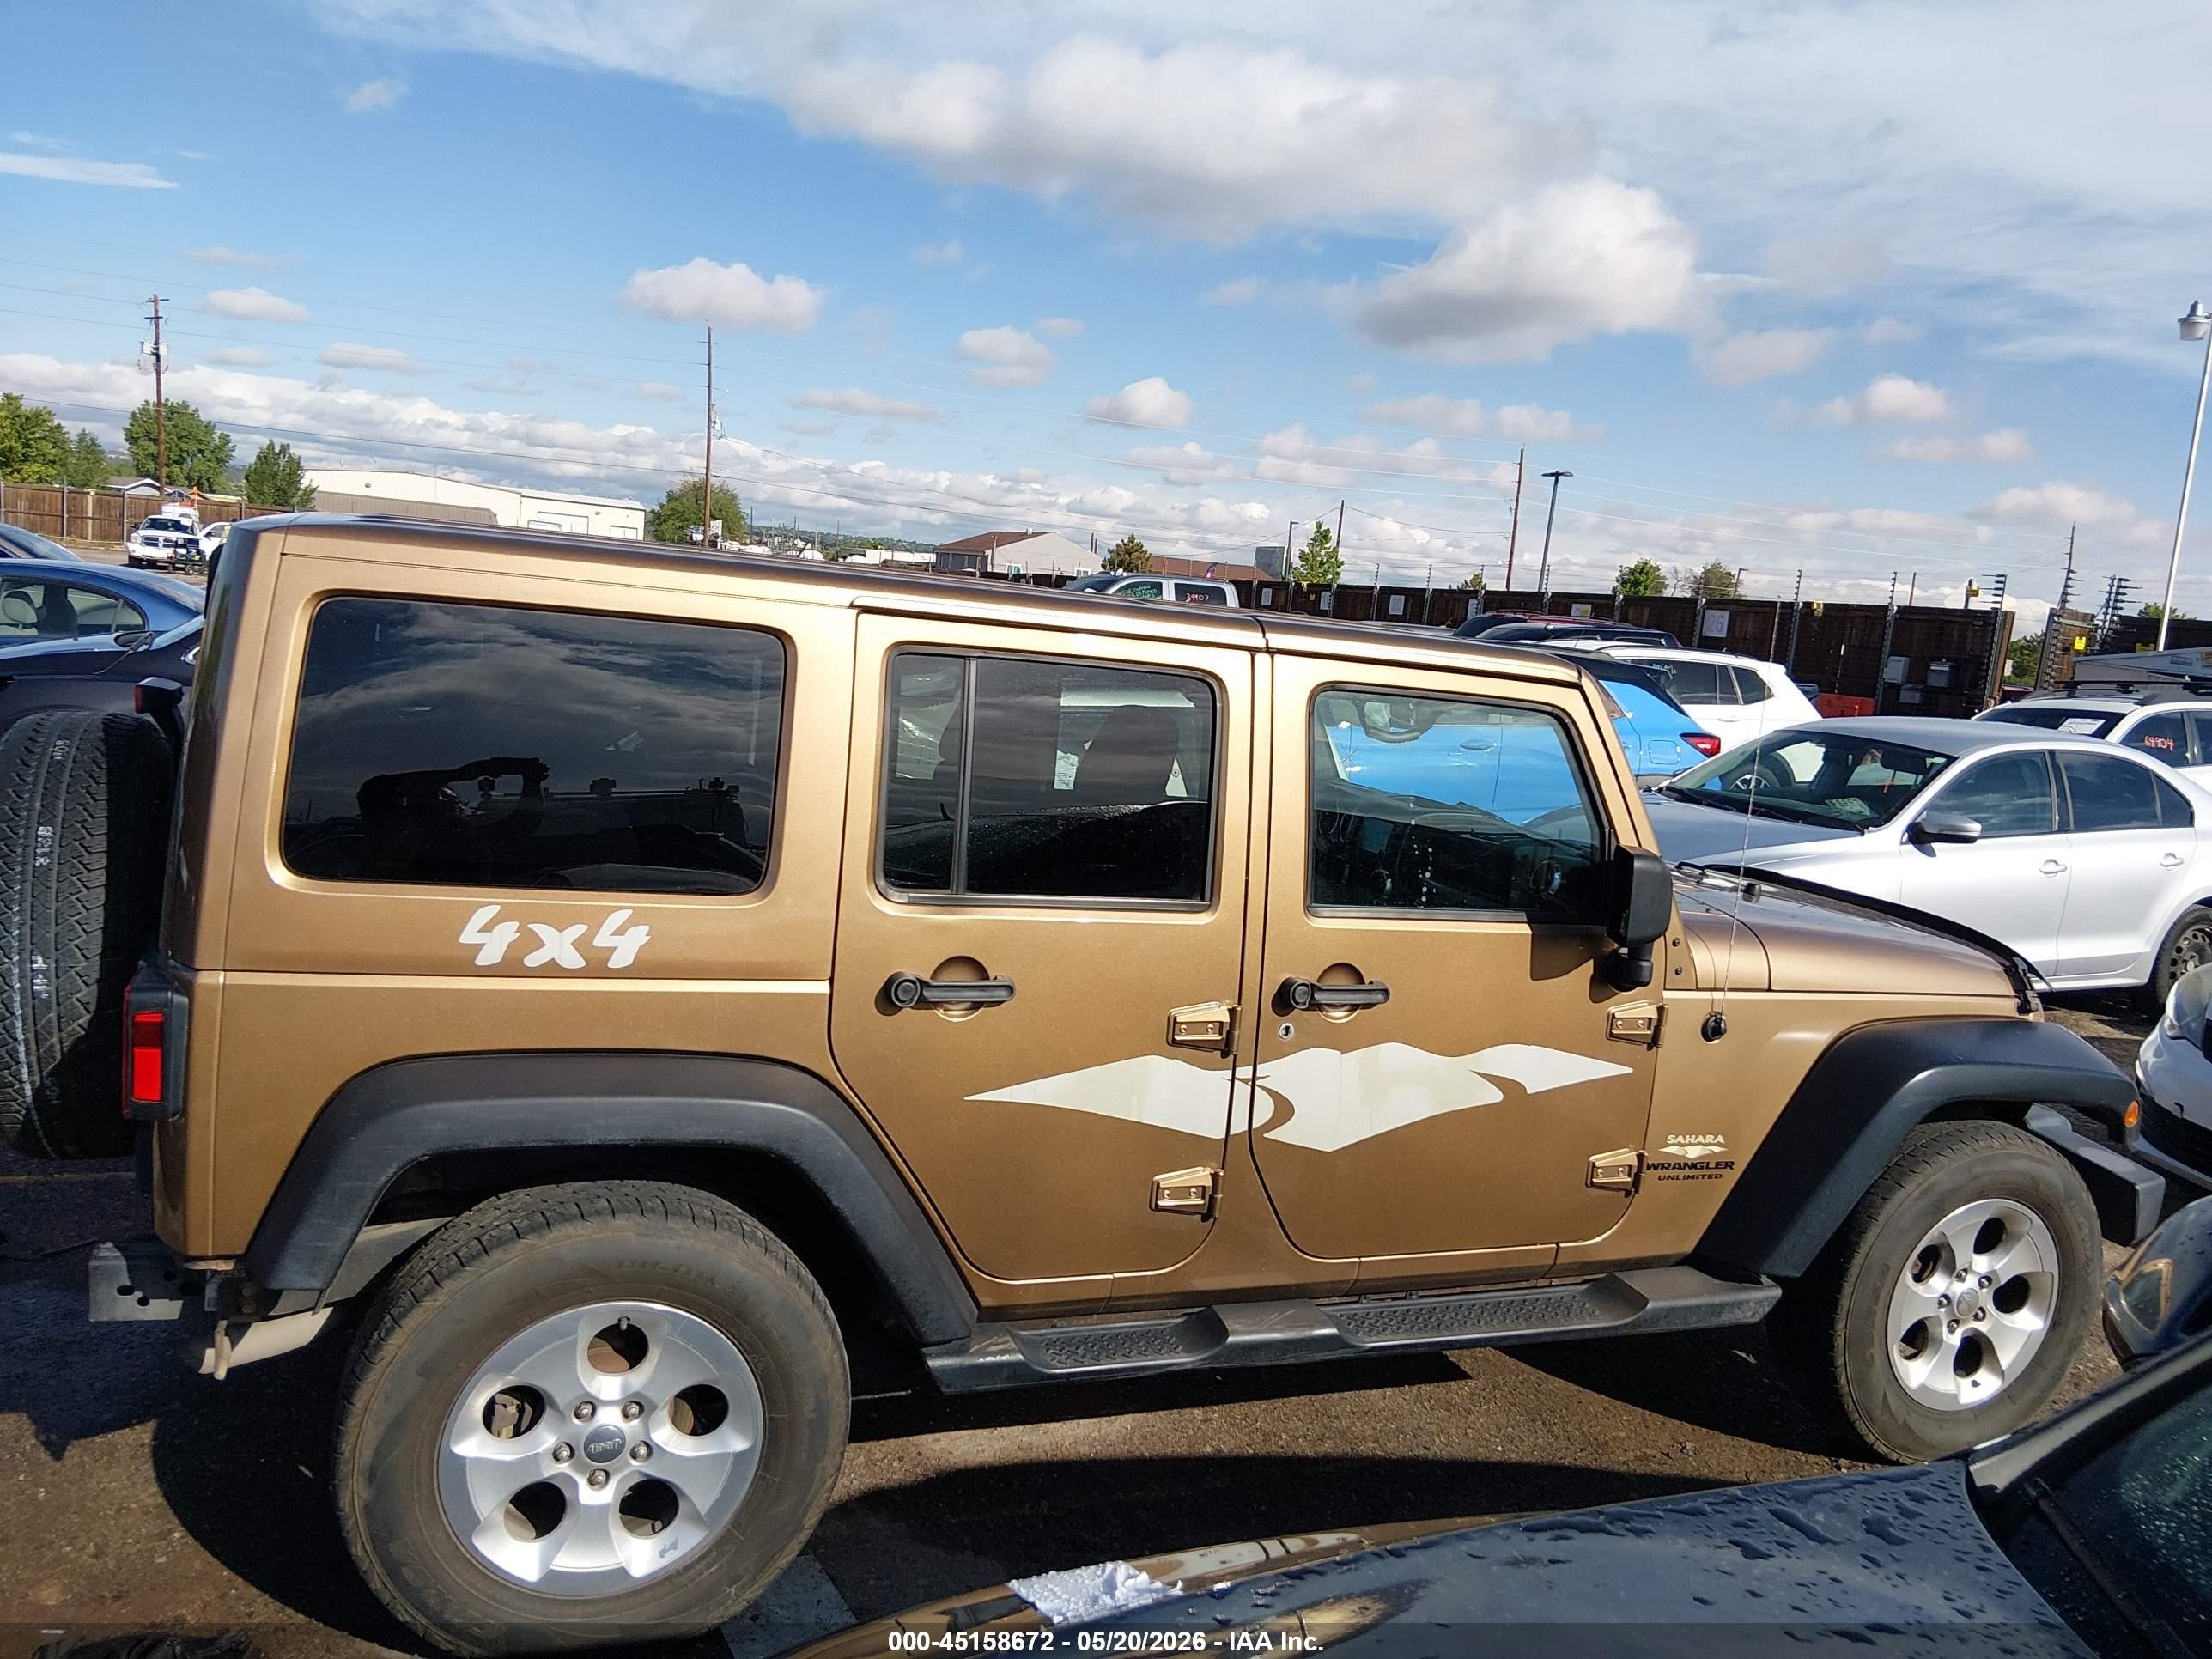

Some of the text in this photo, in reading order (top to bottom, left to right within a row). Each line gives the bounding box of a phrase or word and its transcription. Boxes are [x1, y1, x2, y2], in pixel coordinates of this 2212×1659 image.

[1706, 613, 1724, 633] 26
[458, 904, 652, 969] 4x4
[1666, 1134, 1725, 1145] SAHARA
[1646, 1160, 1735, 1171] WRANGLER
[1657, 1173, 1723, 1182] UNLIMITED
